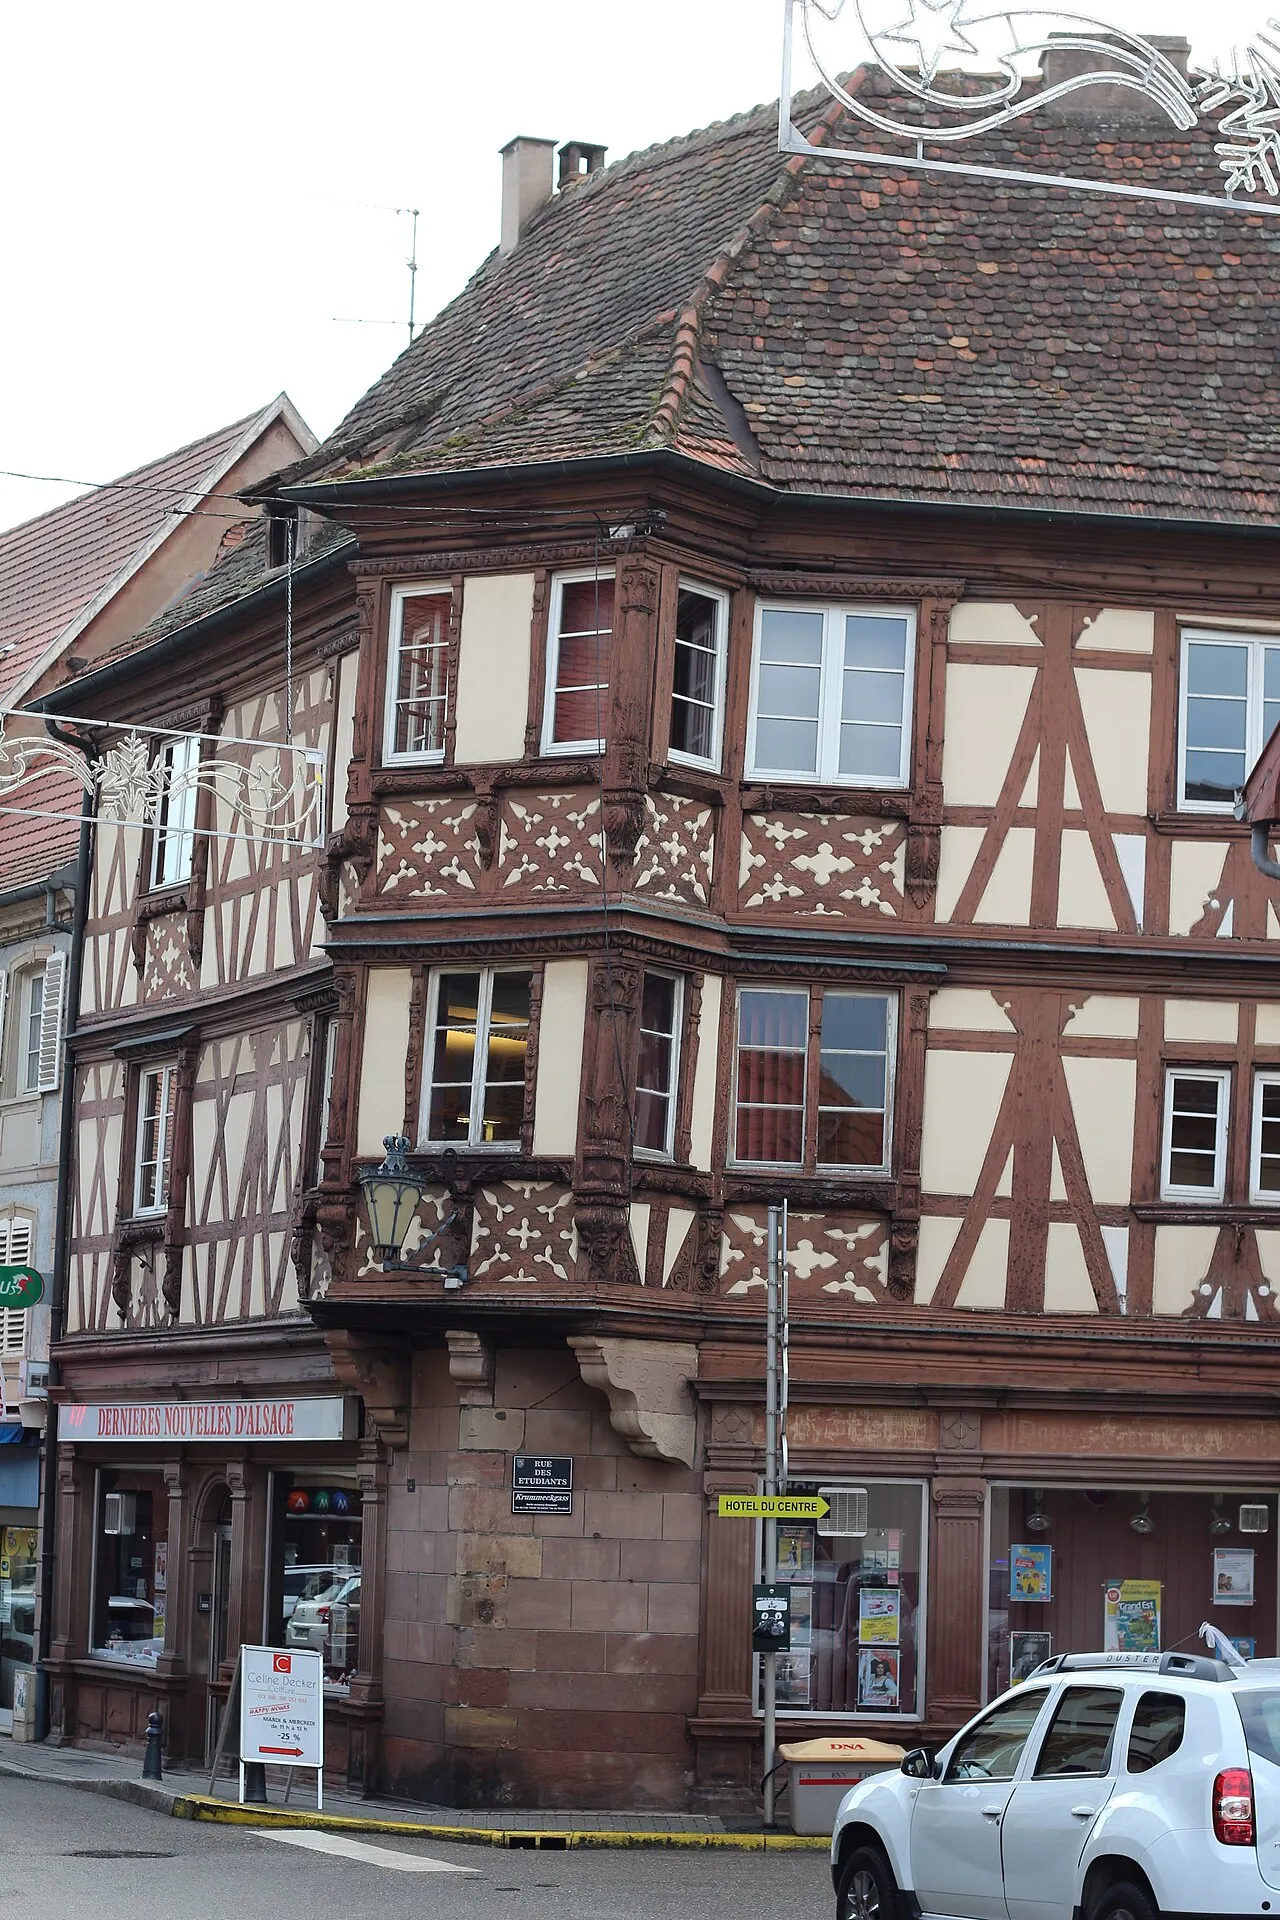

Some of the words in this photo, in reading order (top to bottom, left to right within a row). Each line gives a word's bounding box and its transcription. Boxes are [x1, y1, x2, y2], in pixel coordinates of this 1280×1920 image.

[98, 1408, 160, 1436] DERNIERES
[164, 1405, 232, 1436] NOUVELLES
[234, 1404, 294, 1435] D'ALSACE
[518, 1478, 568, 1486] ETUDIANTS
[515, 1494, 570, 1502] Krummeckgass
[726, 1501, 758, 1510] HOTEL
[761, 1502, 774, 1511] DU
[778, 1502, 818, 1512] CENTRE
[1120, 1602, 1141, 1610] Grand
[1142, 1601, 1154, 1609] Est
[1106, 1655, 1159, 1663] DUSTER
[282, 1676, 316, 1689] Decker
